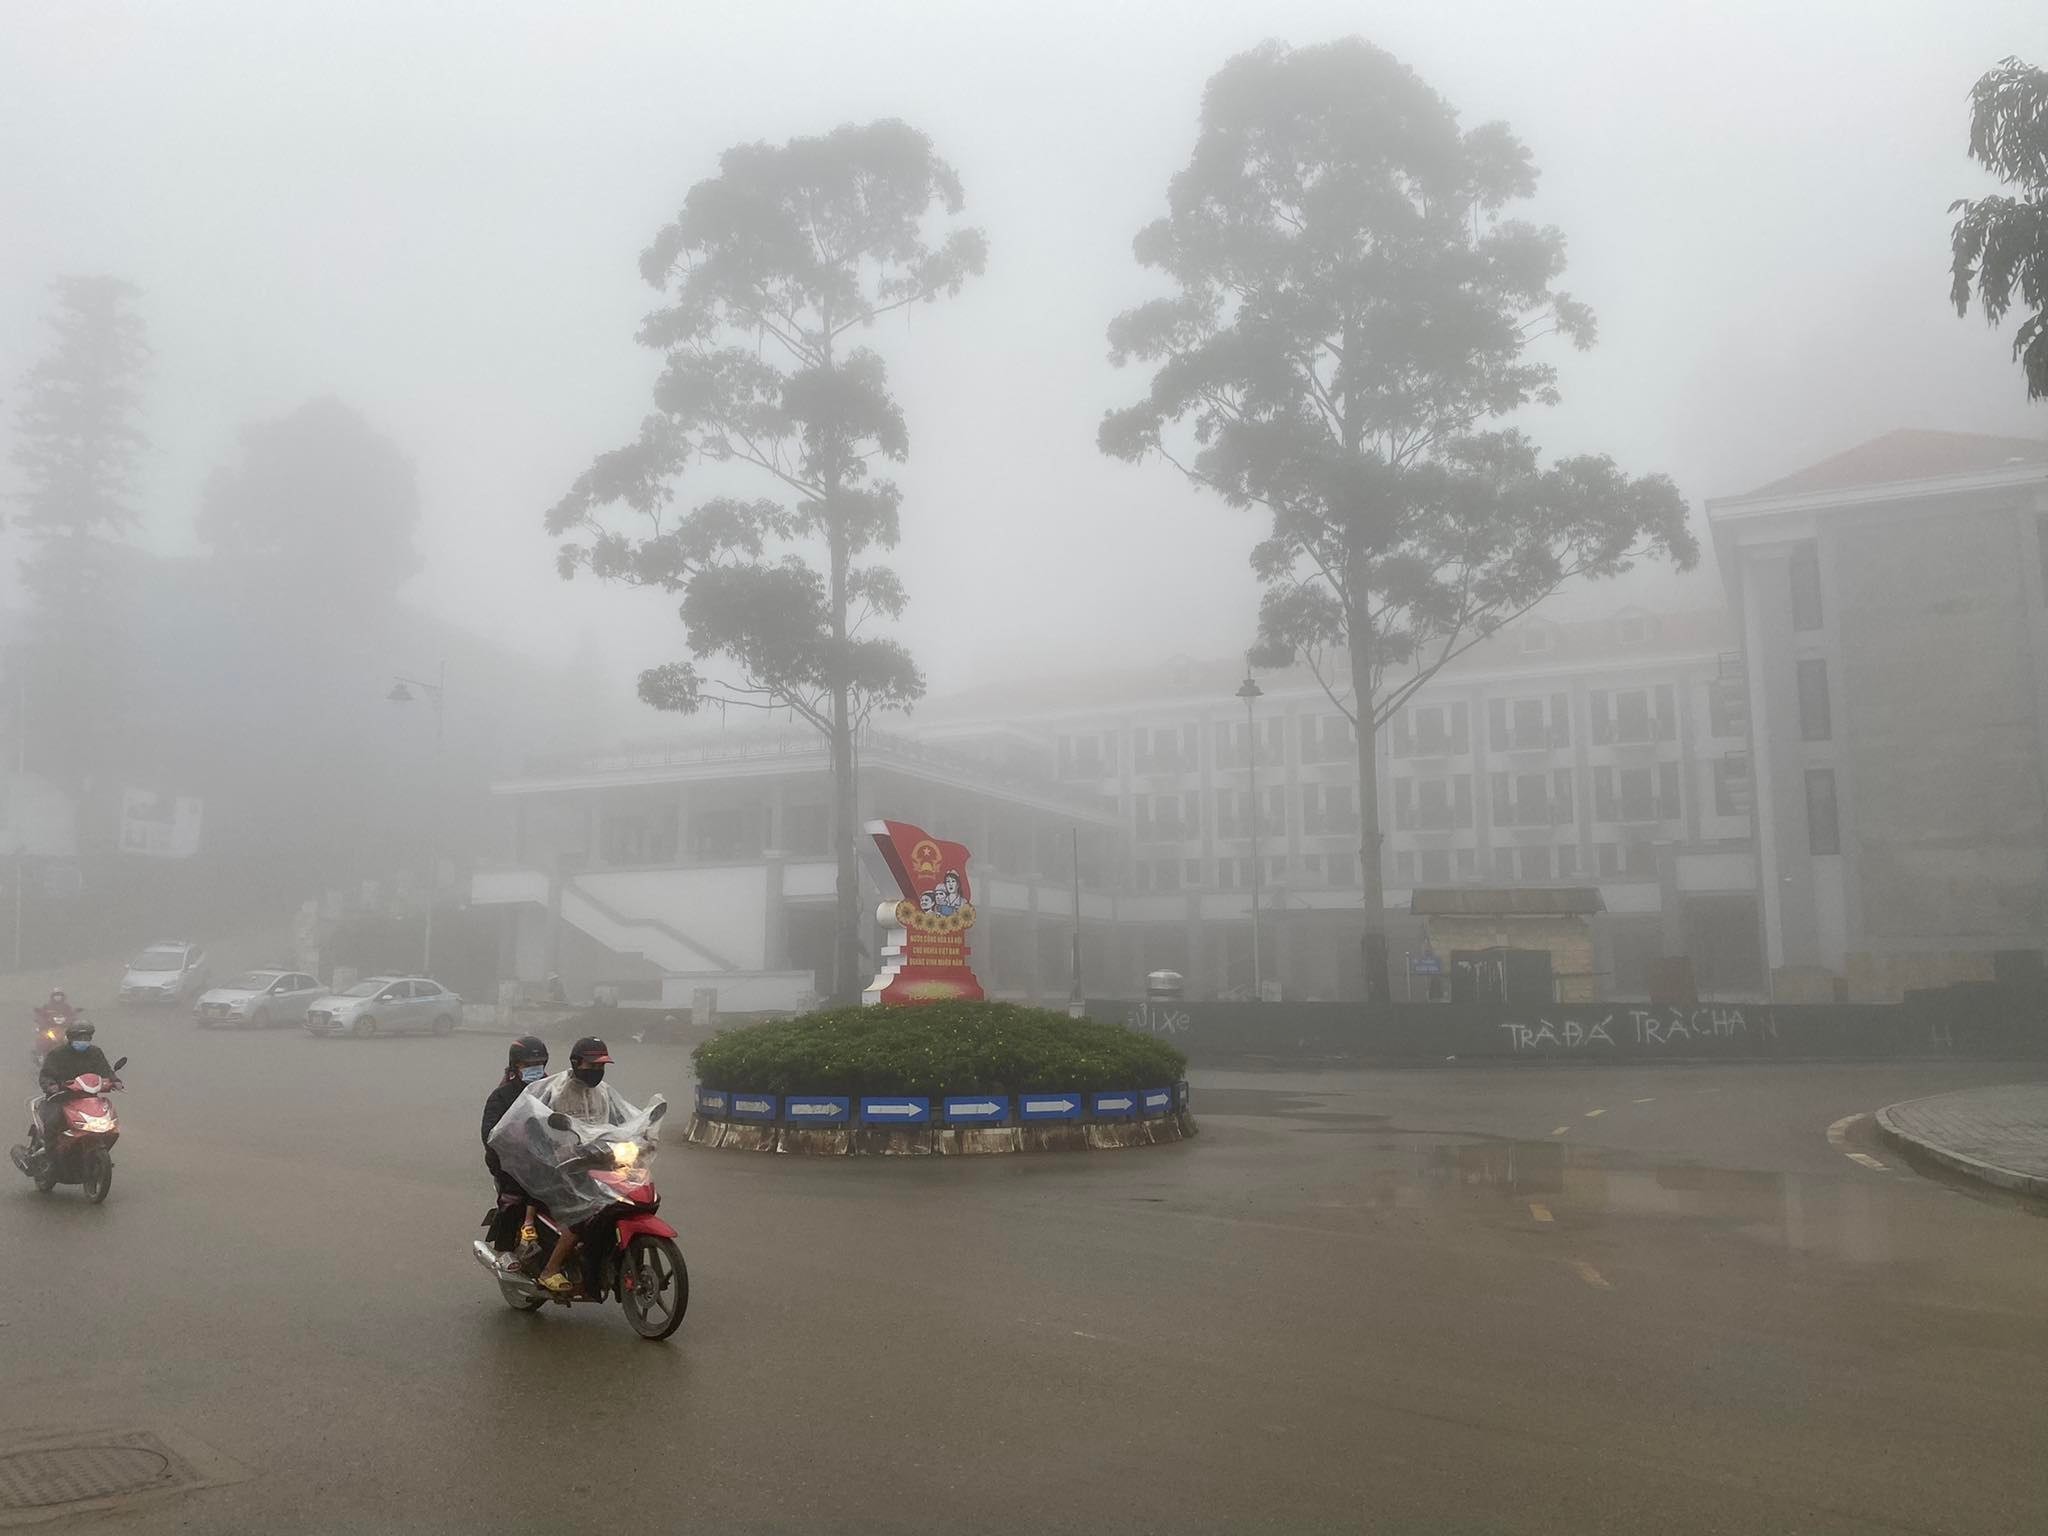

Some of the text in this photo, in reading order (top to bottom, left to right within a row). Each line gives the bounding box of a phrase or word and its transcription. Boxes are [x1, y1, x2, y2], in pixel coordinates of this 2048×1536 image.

[1498, 1018, 1560, 1054] TRÀ
[1561, 1014, 1616, 1048] ĐÁ
[1628, 1006, 1690, 1044] TRÀ
